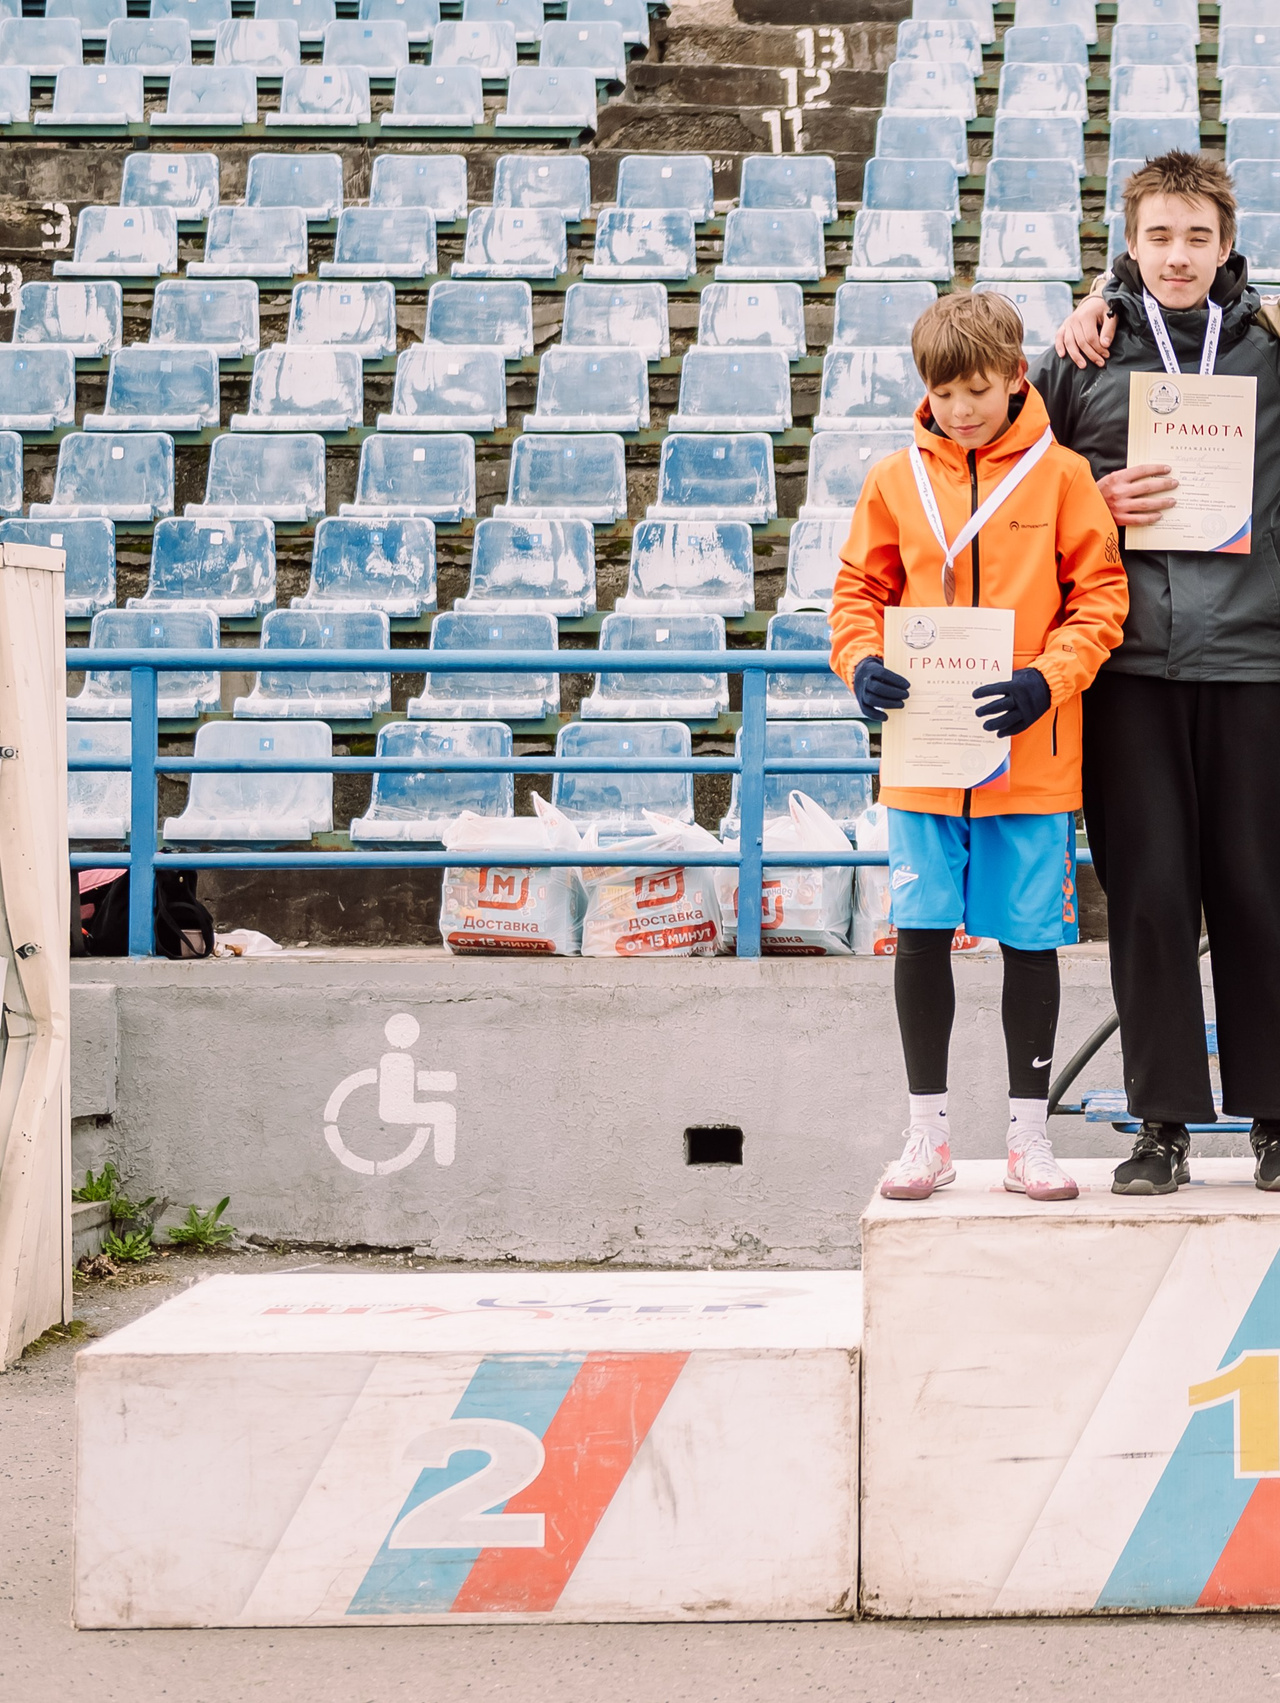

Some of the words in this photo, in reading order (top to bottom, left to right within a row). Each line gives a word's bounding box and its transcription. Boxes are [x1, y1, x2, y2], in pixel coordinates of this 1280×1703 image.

[796, 27, 846, 69] 13
[779, 67, 831, 109] 12
[762, 107, 803, 154] 11
[1153, 422, 1244, 438] ГРАМОТА
[909, 657, 1001, 672] ГРАМОТА
[463, 916, 540, 933] Доставка
[628, 909, 704, 931] Доставка
[480, 938, 497, 946] 15
[625, 940, 644, 952] от
[646, 934, 665, 948] 15
[668, 927, 711, 944] минут
[389, 1417, 546, 1550] 2
